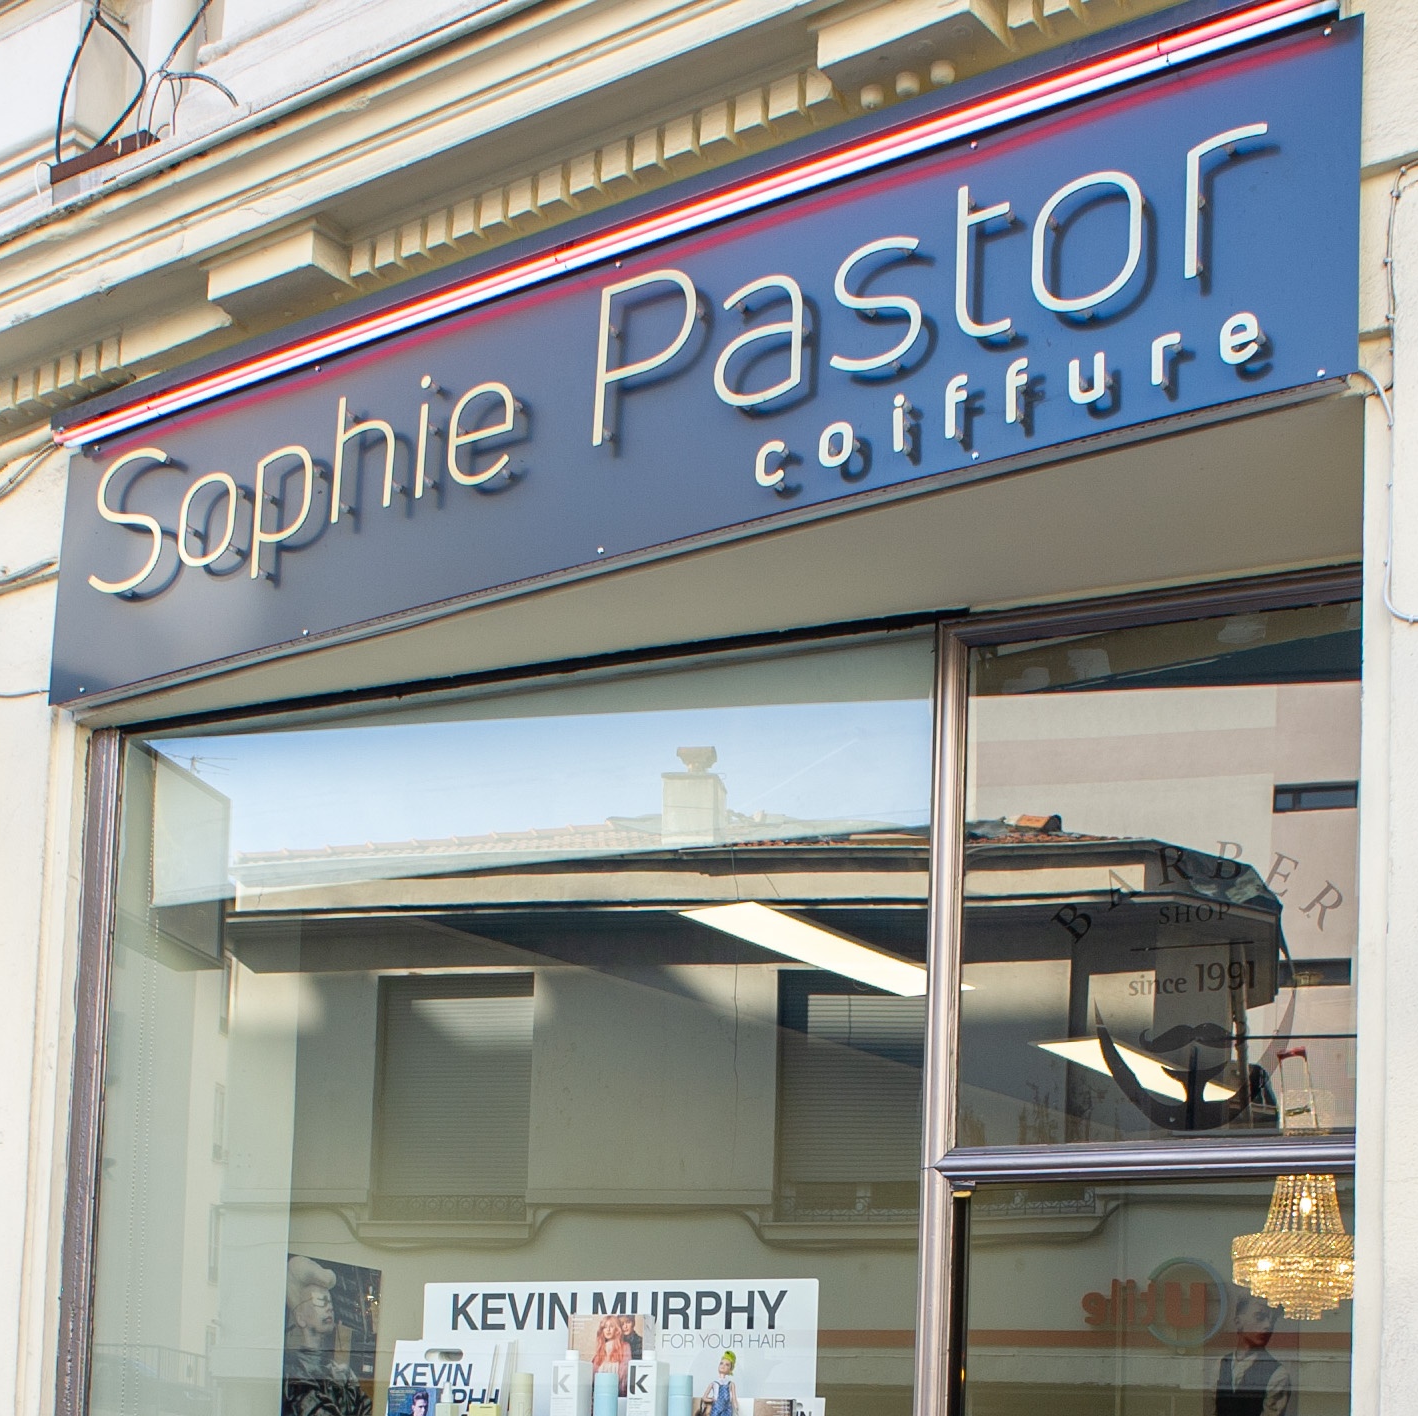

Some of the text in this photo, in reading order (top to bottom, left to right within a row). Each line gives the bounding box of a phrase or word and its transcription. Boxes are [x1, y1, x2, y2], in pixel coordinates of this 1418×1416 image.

[88, 121, 1268, 595] Sophie Pastor
[755, 311, 1264, 488] coiffure
[1050, 840, 1343, 944] BARBER
[1159, 902, 1231, 925] SHOP
[1128, 961, 1255, 997] since 1991
[662, 1333, 785, 1349] FOR YOUR HAIR
[392, 1363, 473, 1387] KEVIN
